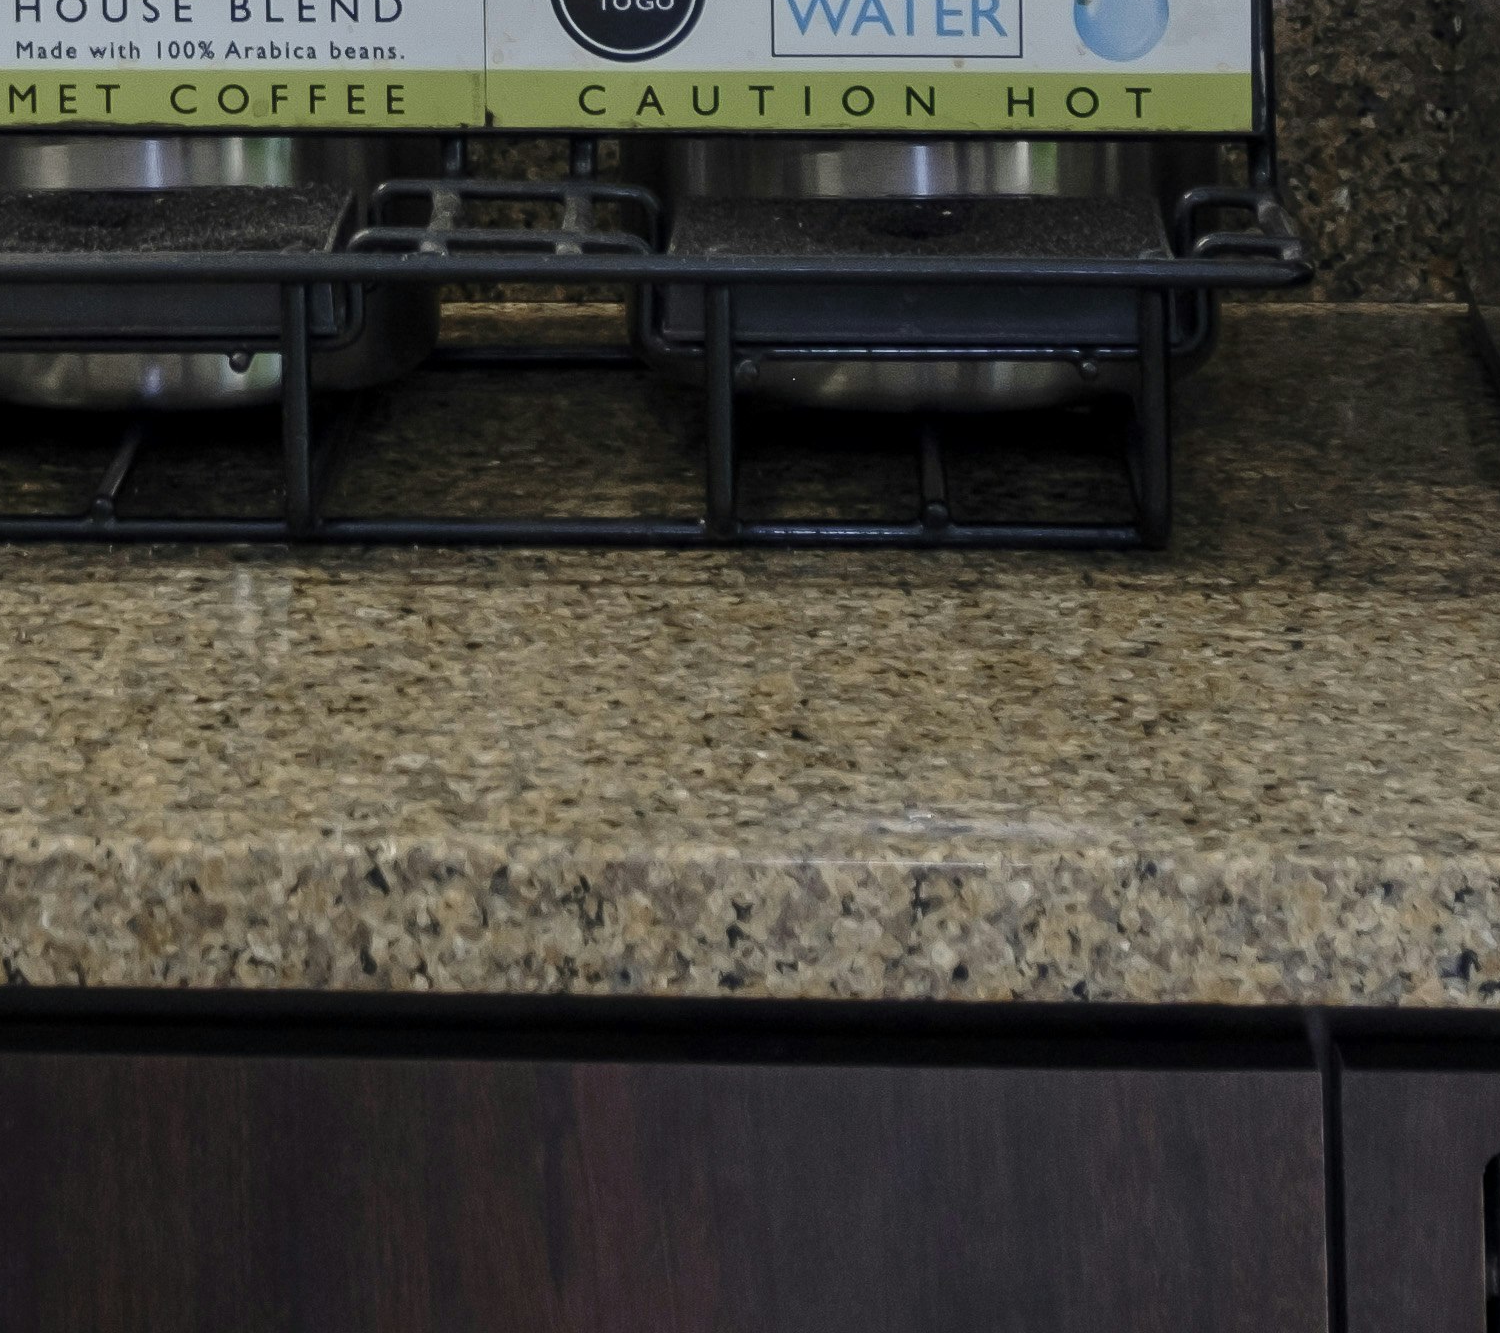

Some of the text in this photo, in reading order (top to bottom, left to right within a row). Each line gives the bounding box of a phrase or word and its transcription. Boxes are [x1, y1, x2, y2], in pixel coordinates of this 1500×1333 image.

[16, 40, 406, 60] Made with 100% Arabica beans.
[170, 83, 405, 115] COFFEE
[578, 84, 1152, 119] CAUTION HOT
